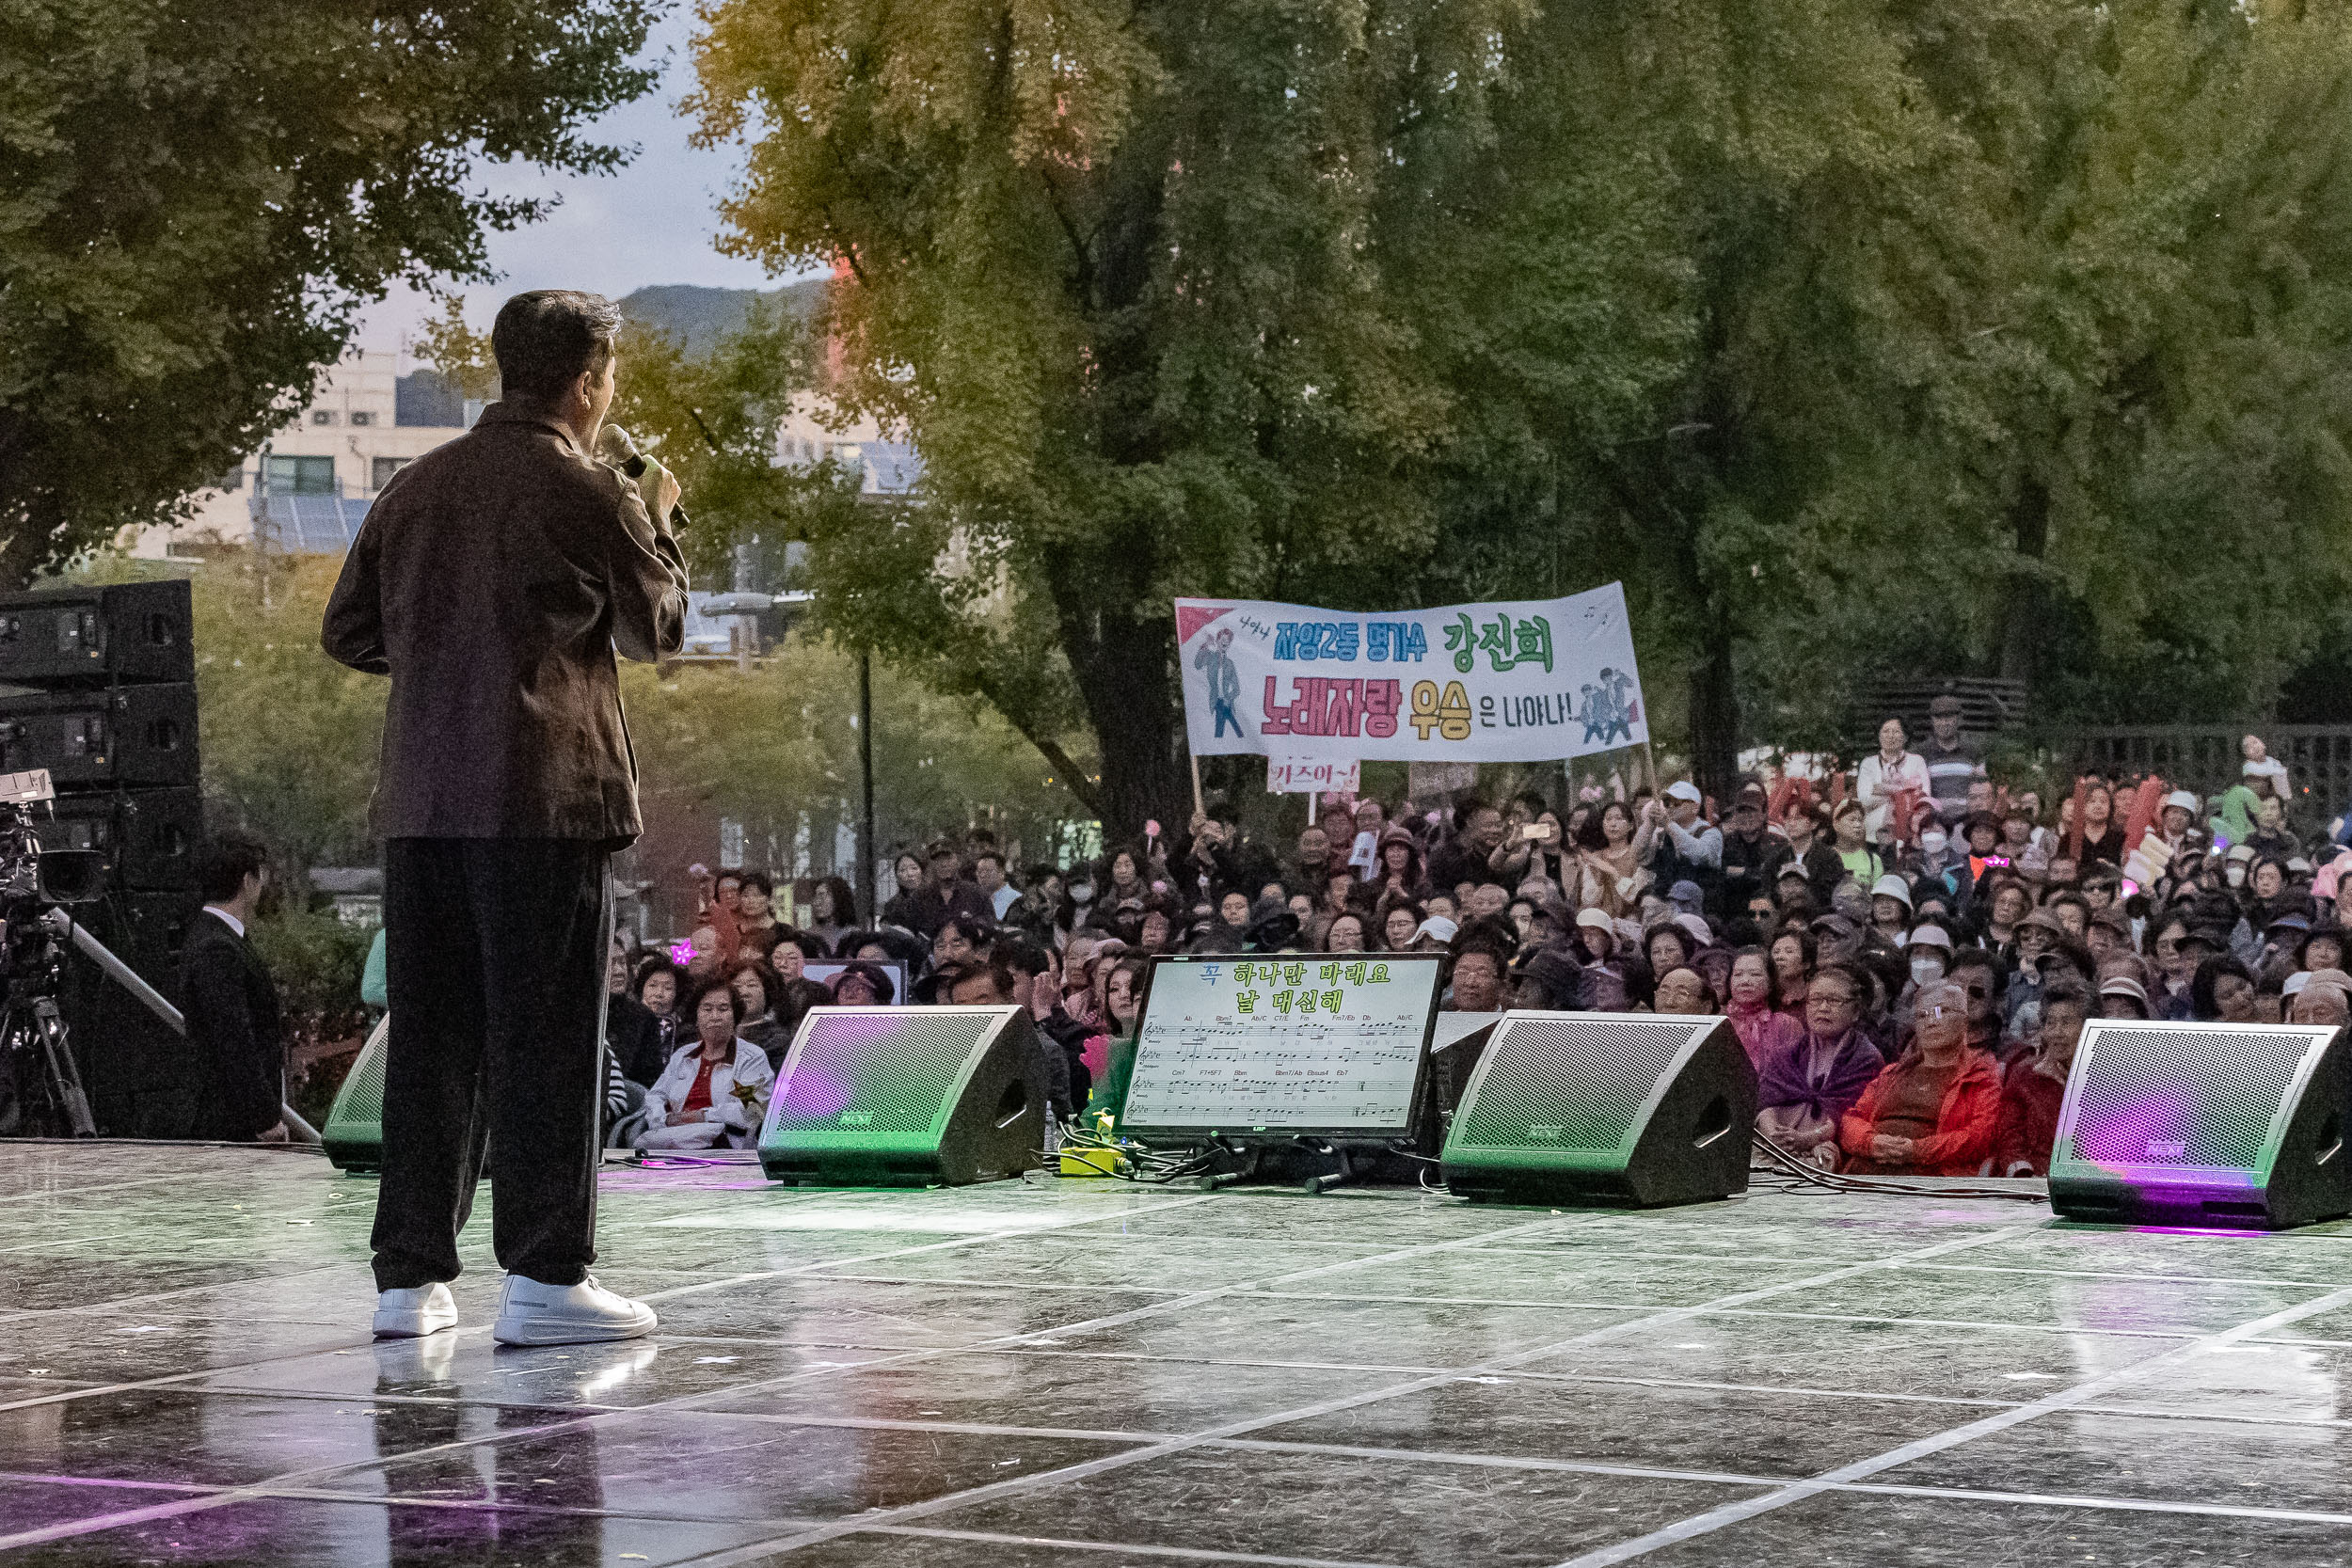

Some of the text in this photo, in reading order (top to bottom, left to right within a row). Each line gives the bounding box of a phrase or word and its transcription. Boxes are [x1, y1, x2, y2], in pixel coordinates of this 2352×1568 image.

[1366, 622, 1428, 662] 명가수
[1442, 612, 1553, 673] 강진희
[1261, 675, 1574, 740] 노래자랑 우승 은 나야나!
[1200, 962, 1391, 987] 꼭 하나만 바래요
[1236, 990, 1343, 1014] 날 대신해
[841, 1113, 872, 1123] NEXT
[1529, 1127, 1562, 1138] NEXT
[2147, 1142, 2185, 1154] NEXT
